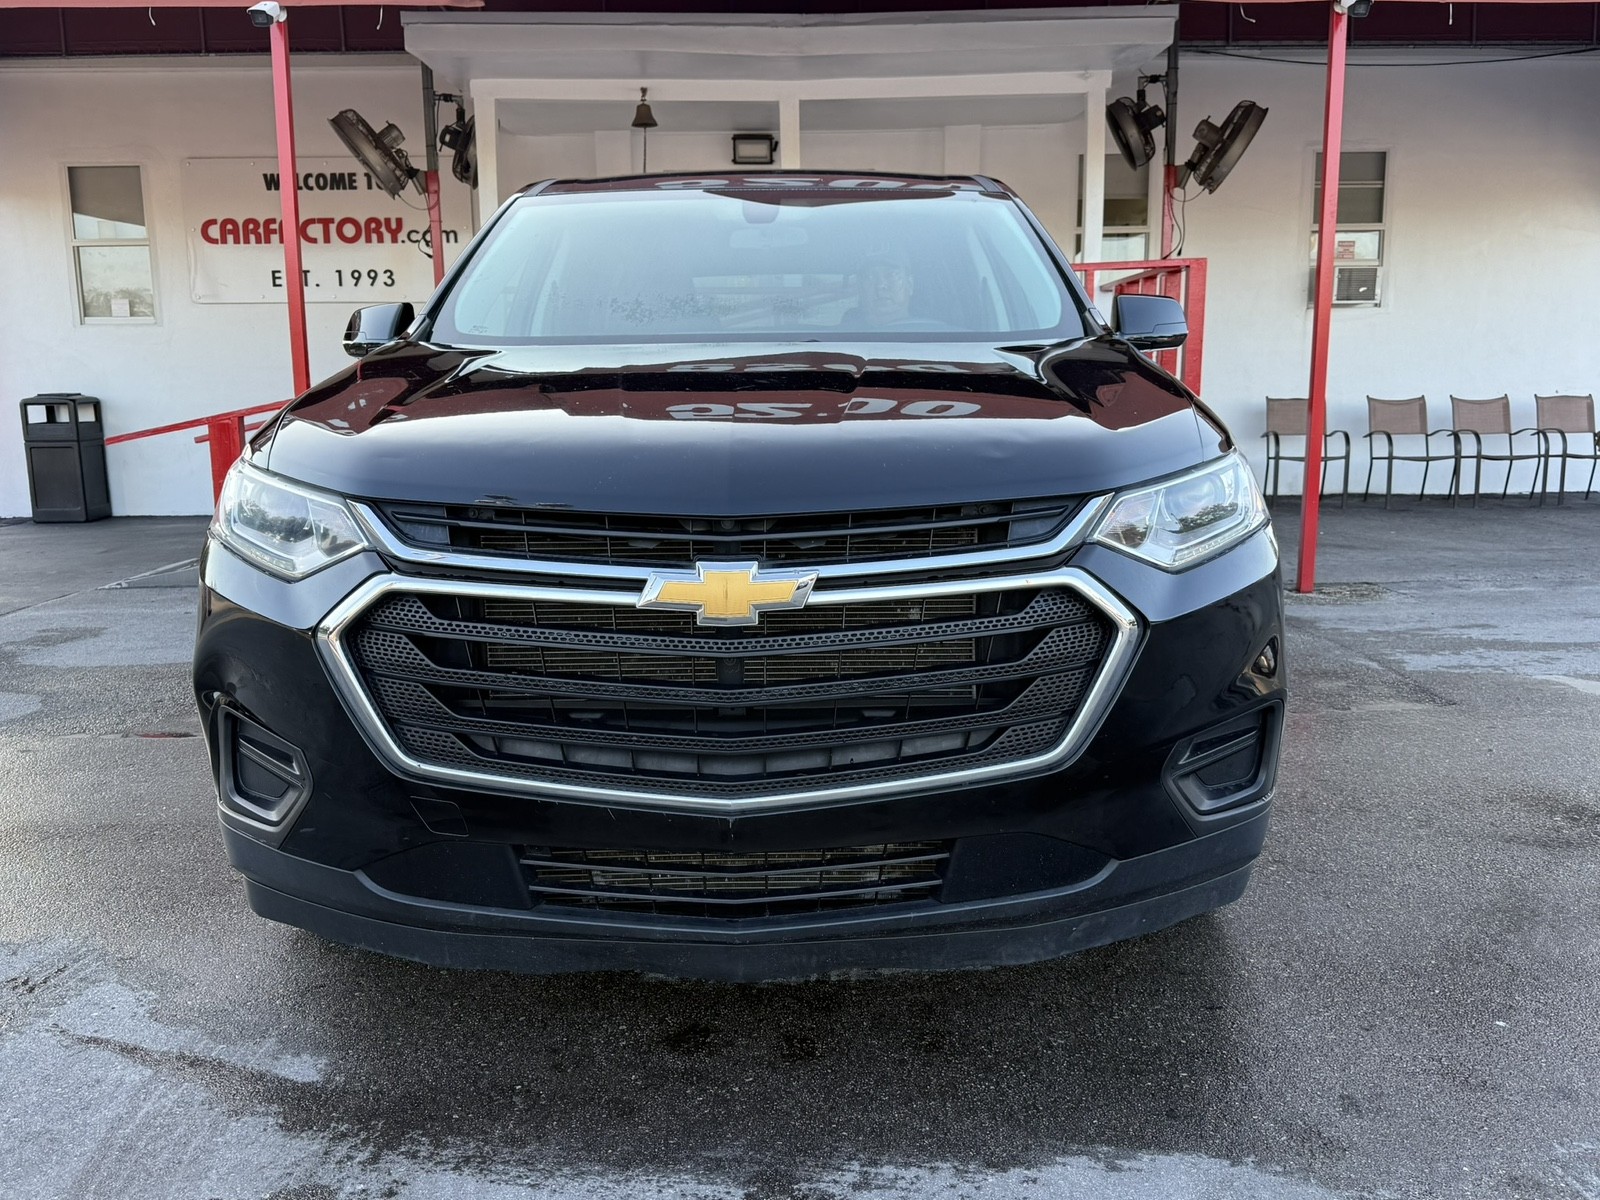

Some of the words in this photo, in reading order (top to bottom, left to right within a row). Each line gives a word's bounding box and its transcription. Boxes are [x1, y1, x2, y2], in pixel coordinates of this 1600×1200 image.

[263, 172, 357, 191] WLCOME
[271, 269, 320, 287] ET.
[335, 269, 396, 287] 1993
